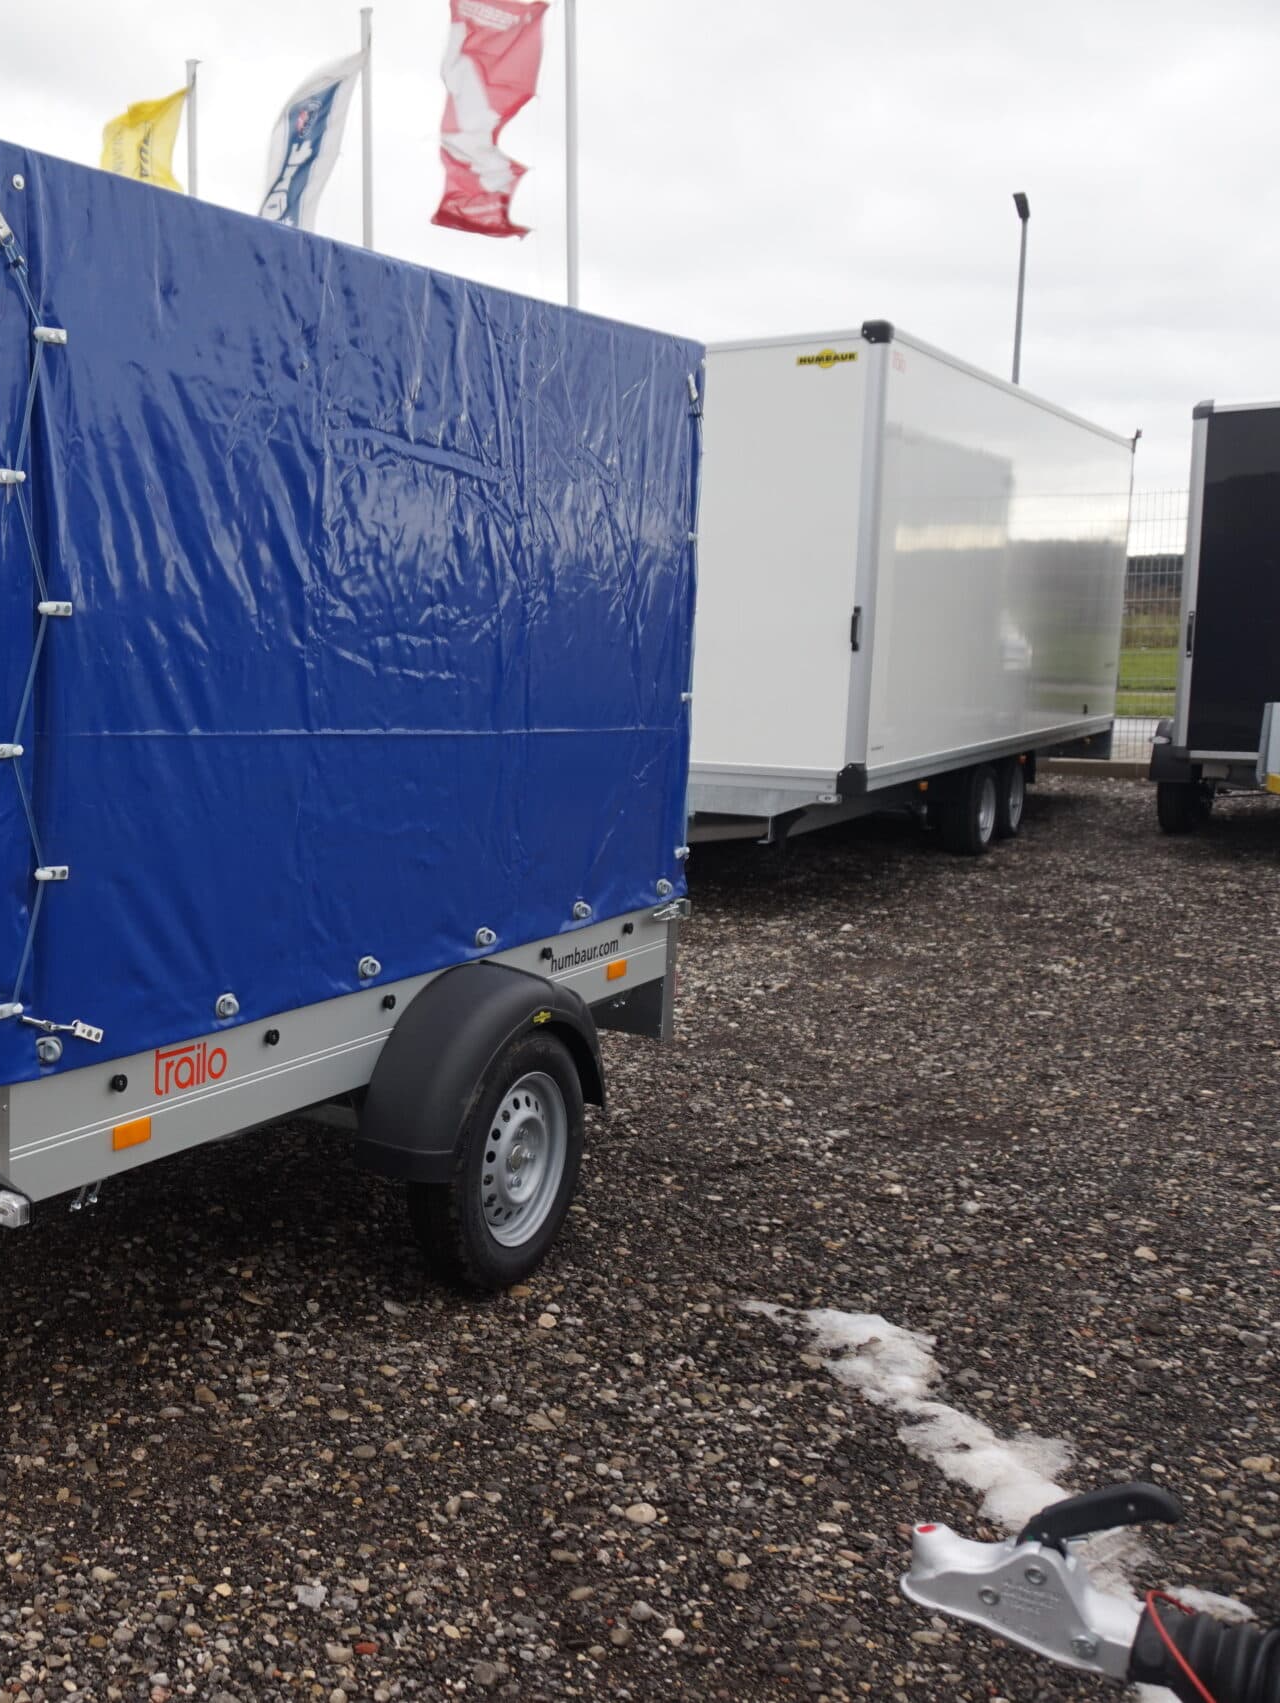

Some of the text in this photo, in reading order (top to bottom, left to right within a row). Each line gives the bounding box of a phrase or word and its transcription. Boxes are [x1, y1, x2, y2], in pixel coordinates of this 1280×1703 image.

[799, 352, 856, 365] HUMBAUR
[551, 939, 619, 973] humbaur.com
[154, 1042, 227, 1096] trailo
